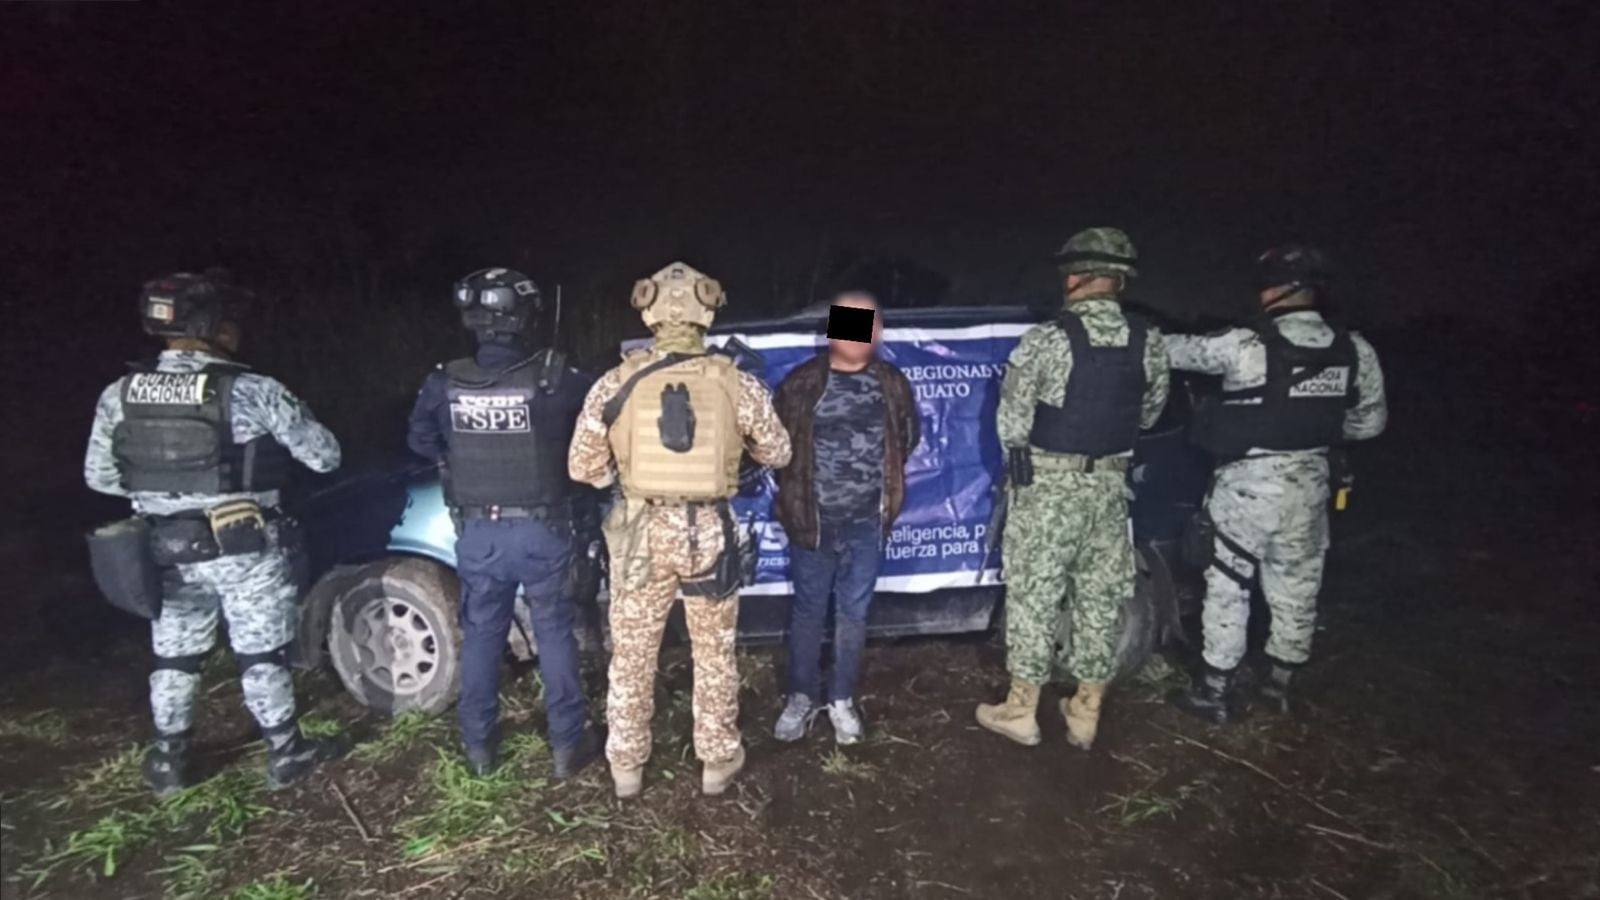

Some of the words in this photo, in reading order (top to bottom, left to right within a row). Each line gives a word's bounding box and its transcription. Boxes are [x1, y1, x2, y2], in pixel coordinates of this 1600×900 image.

[137, 373, 197, 387] GUARDIA
[131, 386, 199, 401] NACIONAL
[885, 541, 937, 560] fuerza
[942, 540, 979, 559] para
